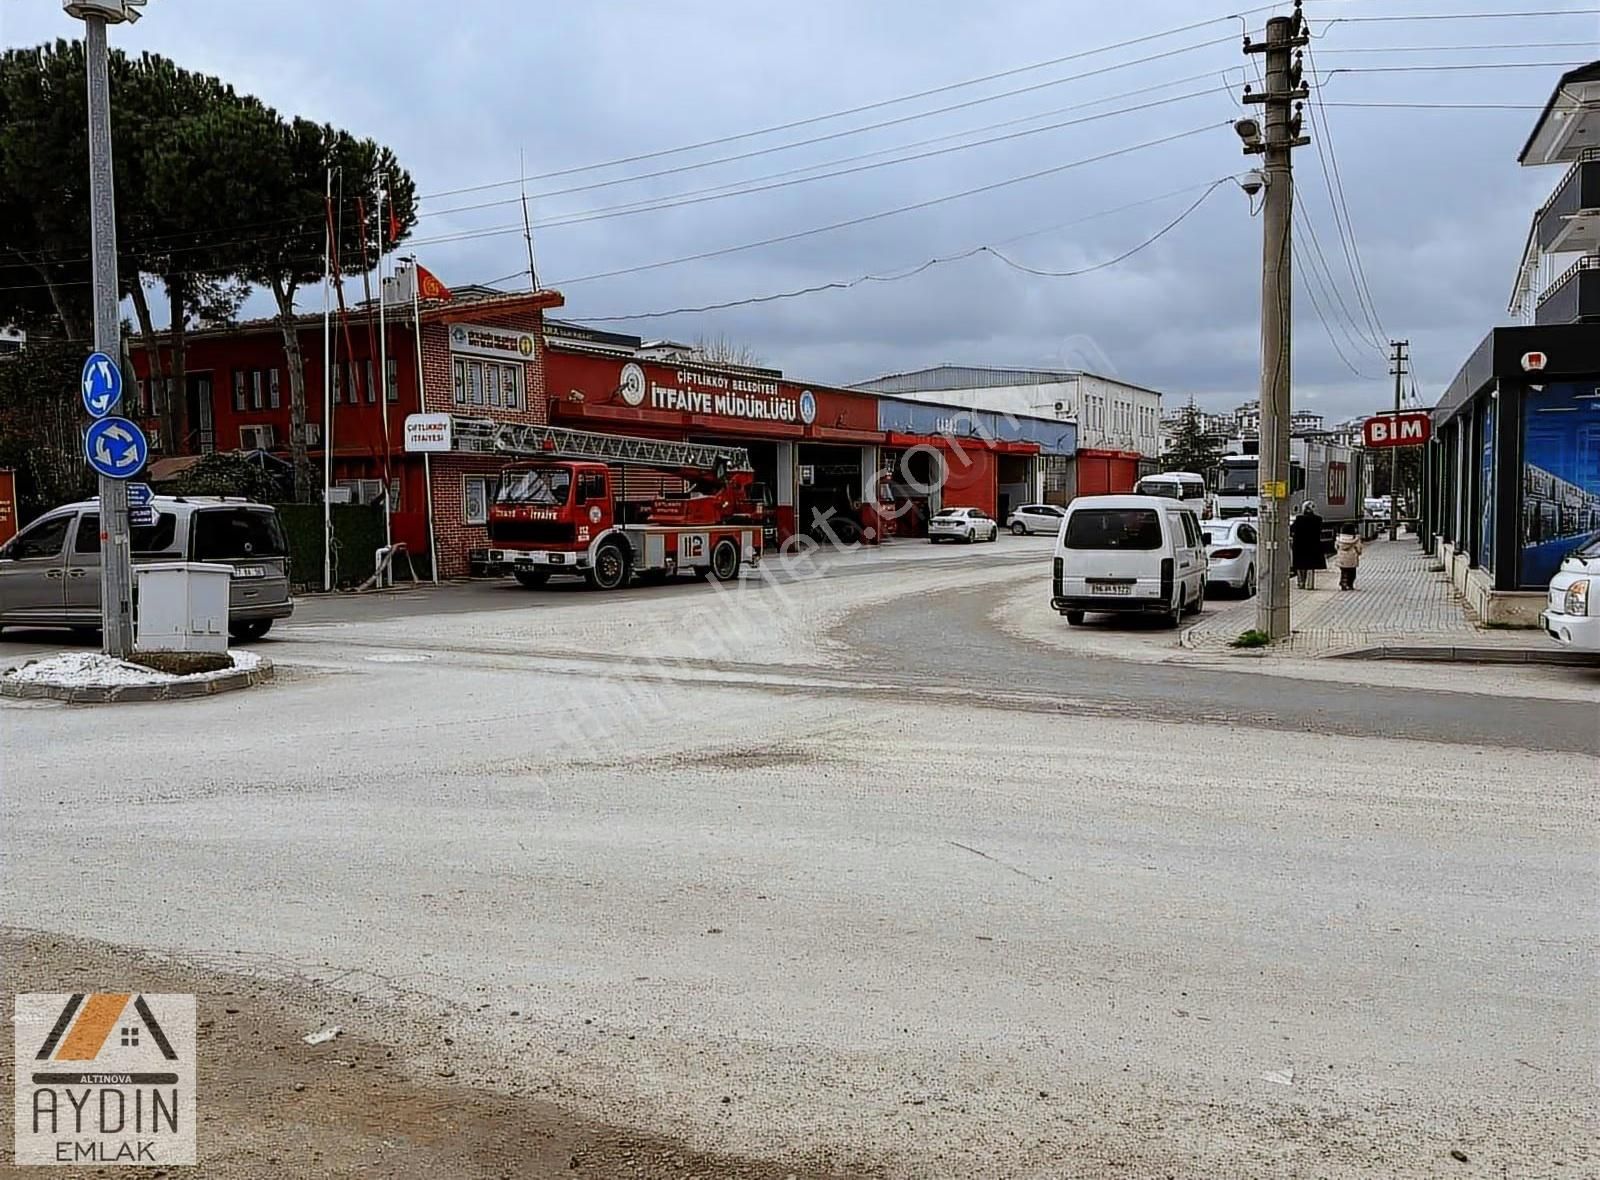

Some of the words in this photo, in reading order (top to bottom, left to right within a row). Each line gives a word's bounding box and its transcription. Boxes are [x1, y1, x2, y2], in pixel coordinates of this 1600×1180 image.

[677, 368, 729, 389] ÇİFTLİKKÖY
[732, 378, 778, 396] BELEDİYESİ
[651, 381, 714, 414] İTFAİYE
[715, 391, 797, 422] MÜDÜRLÜĞÜ
[1371, 417, 1422, 441] BİM
[684, 535, 703, 557] 112
